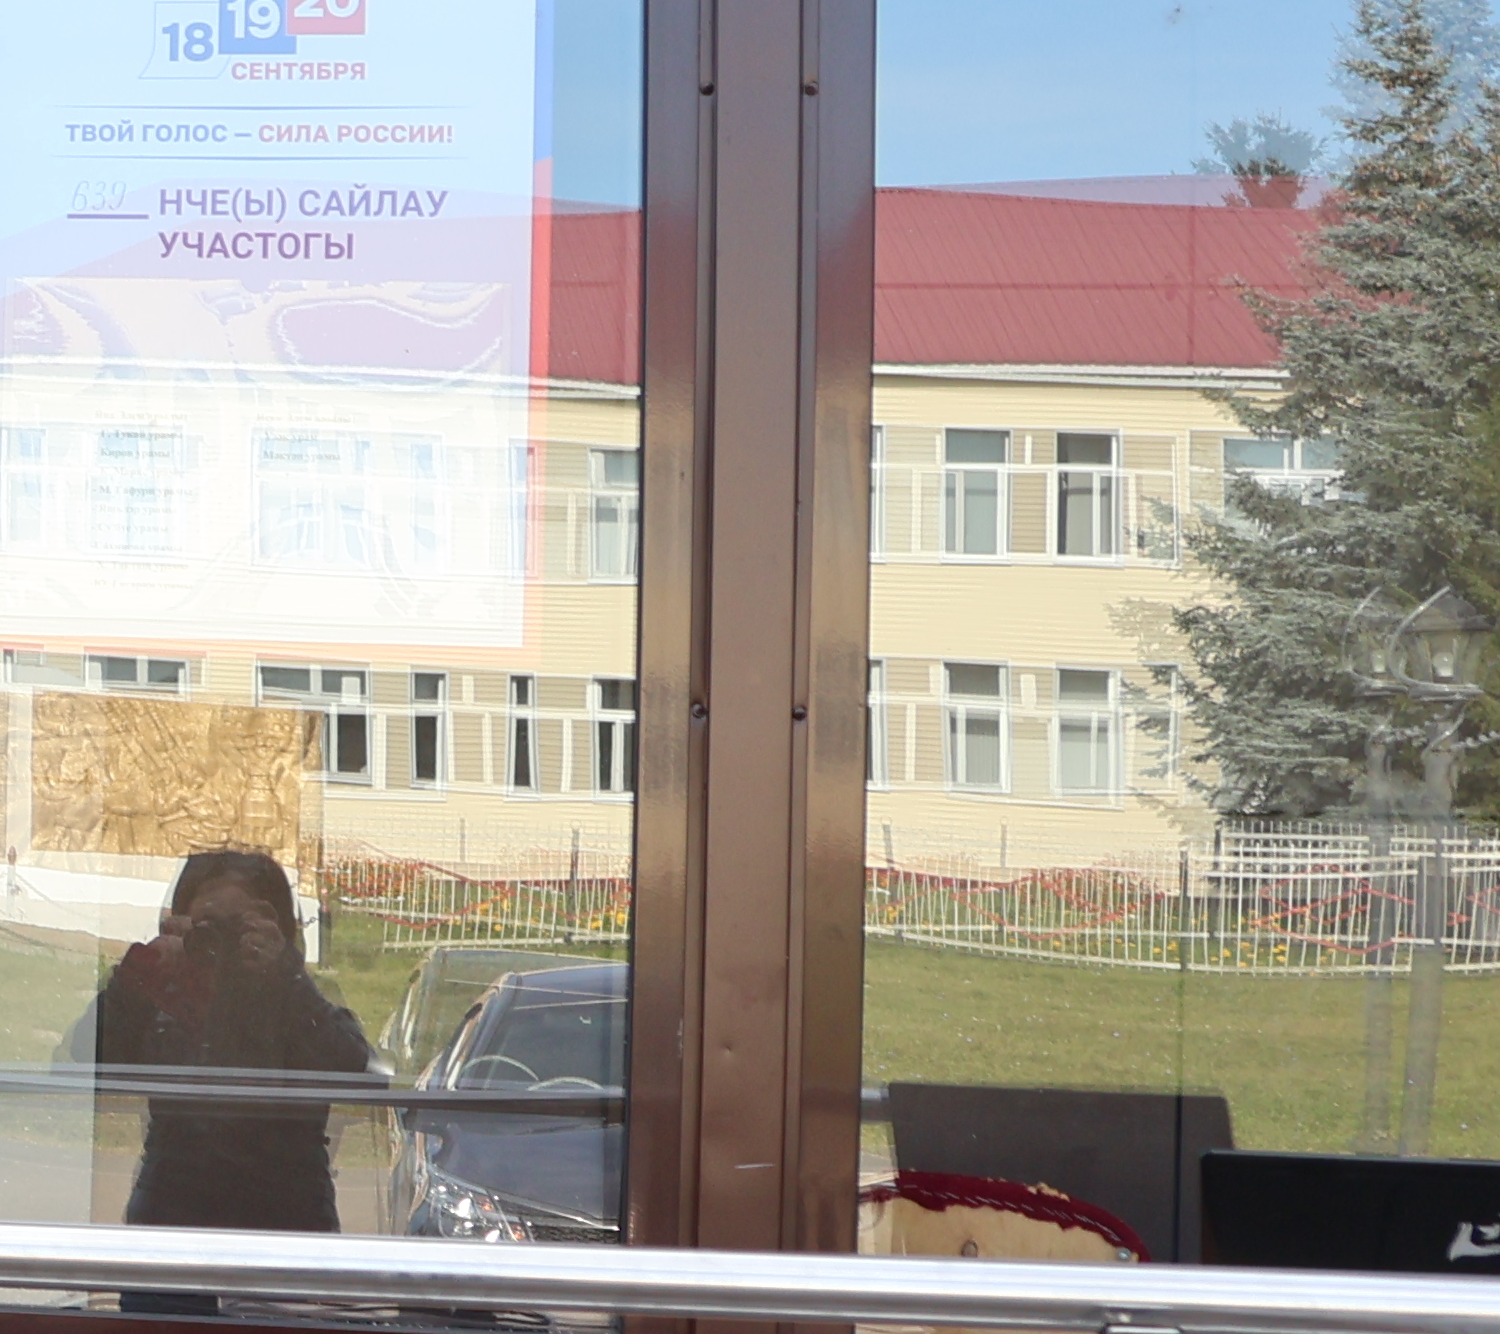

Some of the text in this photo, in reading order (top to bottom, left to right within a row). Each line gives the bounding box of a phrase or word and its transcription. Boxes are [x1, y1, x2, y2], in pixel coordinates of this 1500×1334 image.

[161, 22, 214, 62] 18
[231, 62, 366, 80] СЕНТЯБРЯ
[65, 120, 134, 143] ТВОЙ
[142, 124, 228, 143] ГОЛОС
[258, 124, 330, 143] СИЛА
[337, 124, 453, 143] РОССИИ!
[159, 184, 448, 223] НЧЕ(Ы) САЙЛАУ
[158, 231, 354, 260] УЧАСТОГЫ
